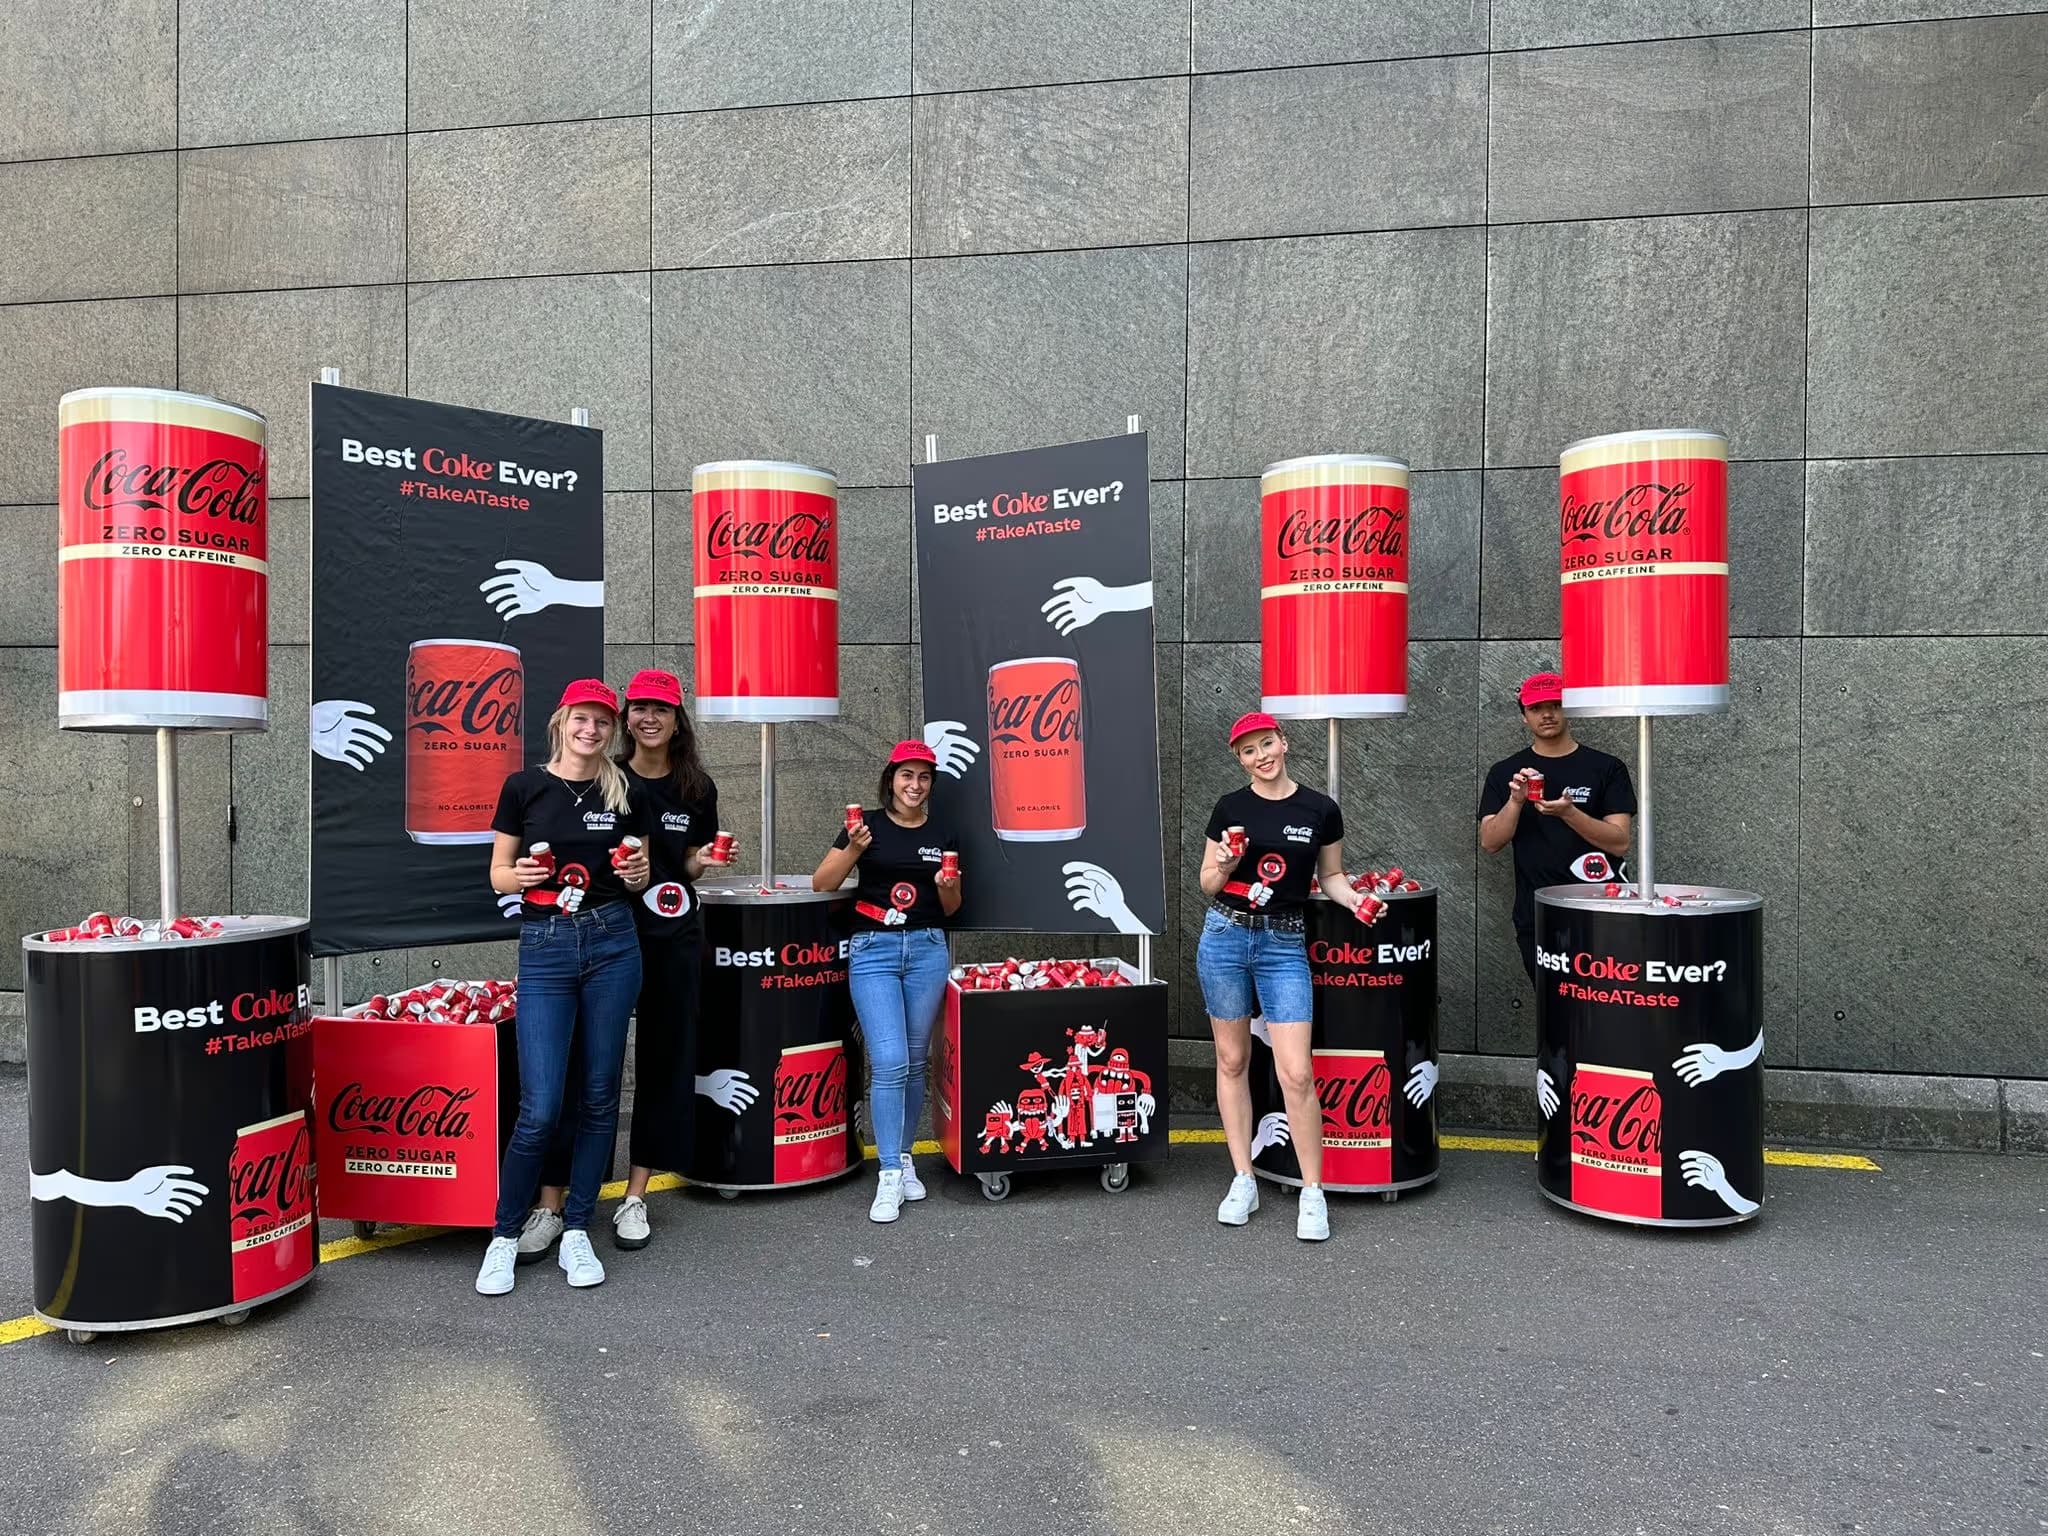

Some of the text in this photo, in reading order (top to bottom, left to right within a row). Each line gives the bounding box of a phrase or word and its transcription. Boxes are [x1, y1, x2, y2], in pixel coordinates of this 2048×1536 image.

[342, 438, 578, 492] Best Coke Ever?
[84, 448, 264, 525] Coca-Cola
[400, 480, 530, 510] #TakeATaste
[933, 480, 1124, 524] Best Coke Ever?
[1561, 482, 1695, 546] Coca-Cola
[103, 525, 250, 551] ZERO SUGAR
[707, 510, 832, 562] Coca-Cola
[975, 517, 1081, 542] #TakeATaste
[1277, 506, 1404, 559] Coca-Cola
[122, 546, 236, 564] ZERO CAFFEINE
[1565, 548, 1673, 569] ZERO SUGAR
[719, 570, 822, 584] ZERO SUGAR
[1289, 566, 1394, 581] ZERO SUGAR
[1572, 565, 1656, 580] ZERO CAFFEINE
[732, 586, 812, 595] ZERO CAFFEINE
[1303, 582, 1384, 592] ZERO CAFFEINE
[424, 741, 507, 751] ZERO SUGAR
[1003, 748, 1070, 759] ZERO SUGAR
[715, 946, 775, 967] Best
[780, 942, 835, 966] Coke
[1310, 939, 1431, 965] Coke Ever?
[1536, 945, 1727, 983] Best Coke Ever?
[760, 969, 847, 989] #TakeATas
[1312, 972, 1404, 987] akeATaste
[1558, 981, 1680, 1007] #TakeATaste
[134, 999, 224, 1033] Best
[231, 988, 295, 1022] Coke
[328, 1083, 480, 1138] Coca-Cola
[785, 1119, 840, 1135] ZERO SUGAR
[785, 1127, 840, 1142] ZERO CAFFEINE
[1323, 1131, 1381, 1139] ERO SUGAR
[345, 1145, 457, 1163] ZERO SUGAR
[1580, 1147, 1649, 1166] ZERO SUGAR
[348, 1161, 453, 1176] ZERO CAFFEINE
[1580, 1156, 1649, 1174] ZERO CAFFEINE
[245, 1209, 306, 1237] ZERO SUGAR
[246, 1218, 307, 1247] ZERO CAFFEINE
